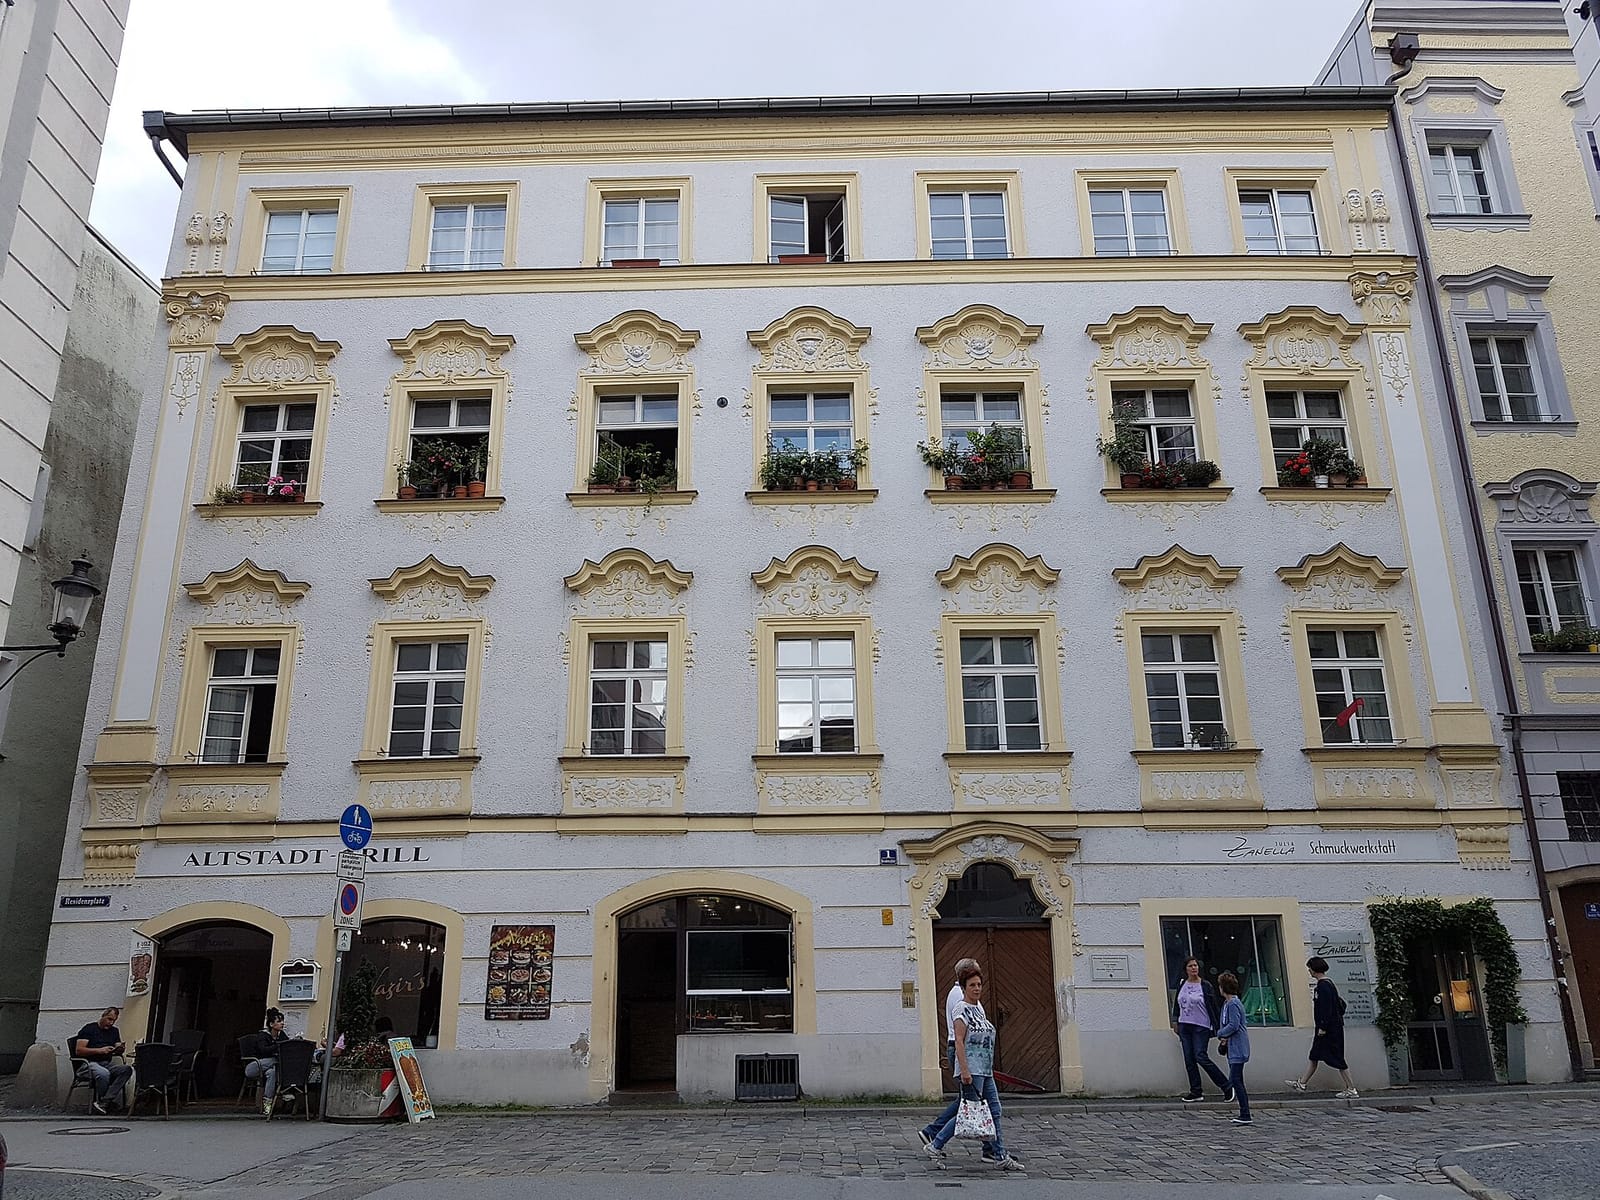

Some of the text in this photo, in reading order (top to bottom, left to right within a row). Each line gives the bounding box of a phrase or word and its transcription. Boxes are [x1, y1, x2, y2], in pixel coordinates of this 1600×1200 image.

[1222, 836, 1397, 858] ZANELLA Schmuckwerkstatt
[183, 847, 431, 869] ALTSTADT-RILL
[339, 915, 354, 926] ZONE
[1313, 935, 1362, 956] ZANELLA
